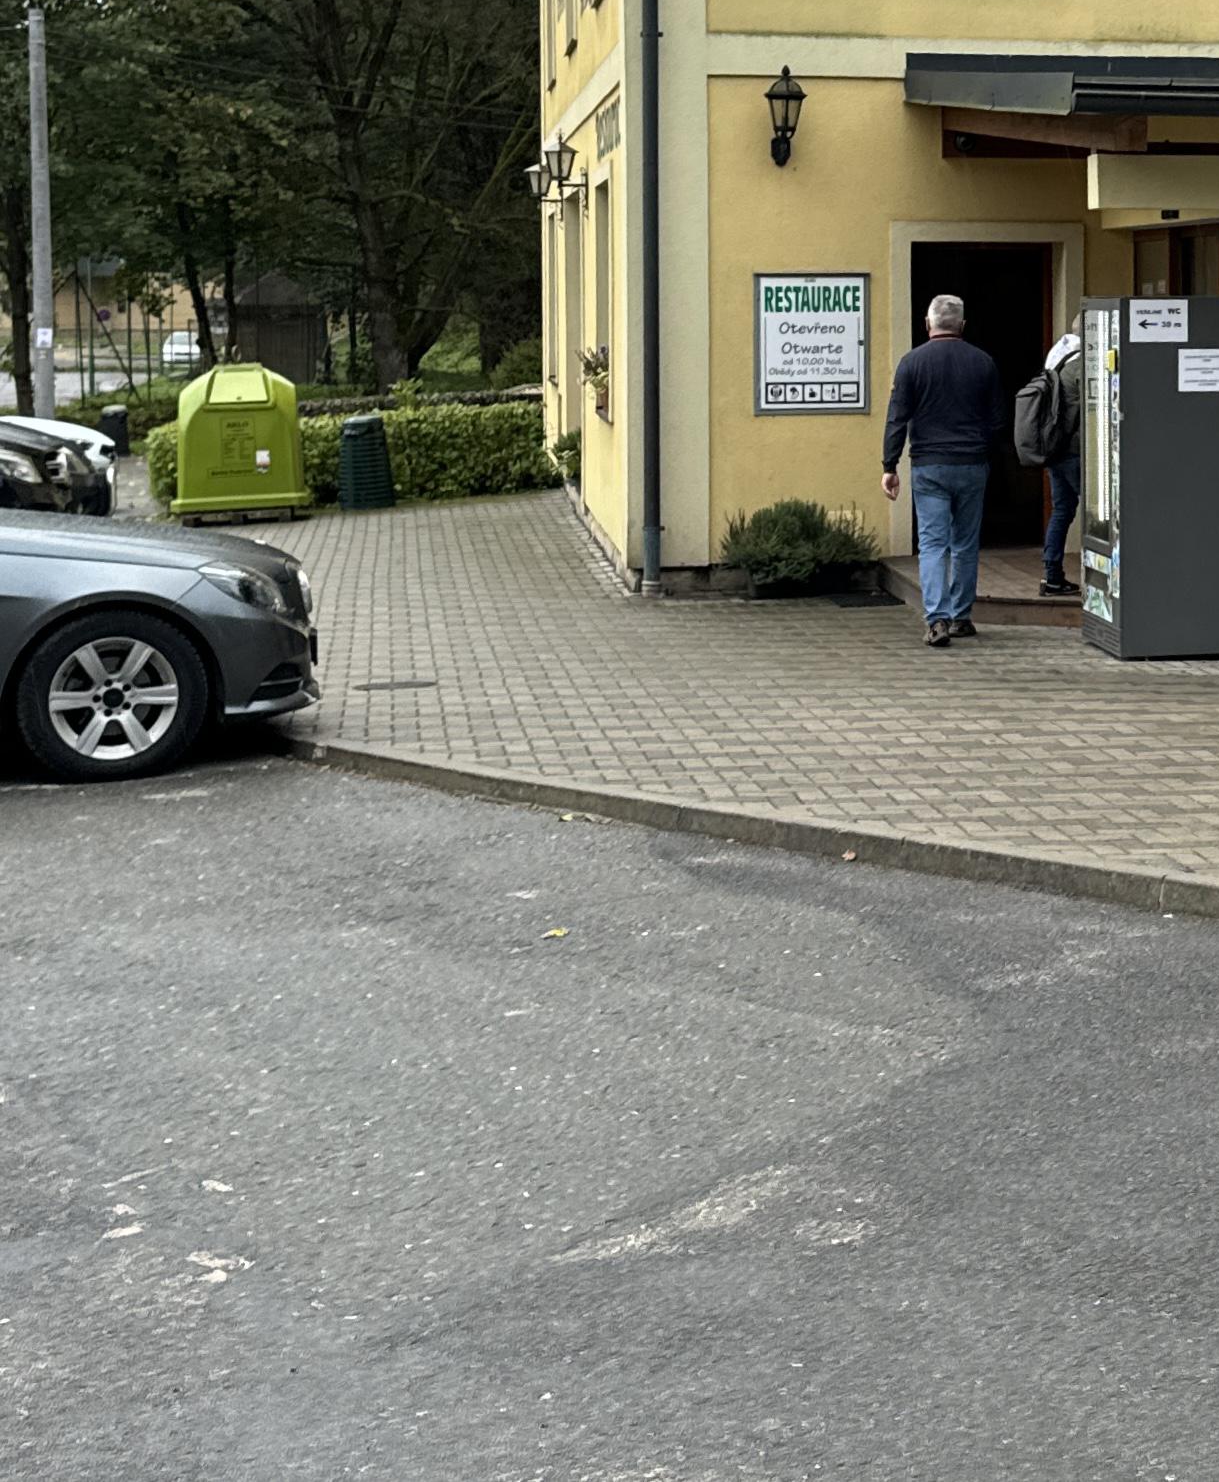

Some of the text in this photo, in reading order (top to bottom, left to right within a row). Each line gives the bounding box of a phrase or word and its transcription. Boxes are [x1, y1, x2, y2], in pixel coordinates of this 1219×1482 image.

[764, 285, 860, 313] RESTAURACE
[778, 321, 846, 335] Otevřeno
[781, 341, 844, 355] Otwarte
[782, 358, 794, 366] od
